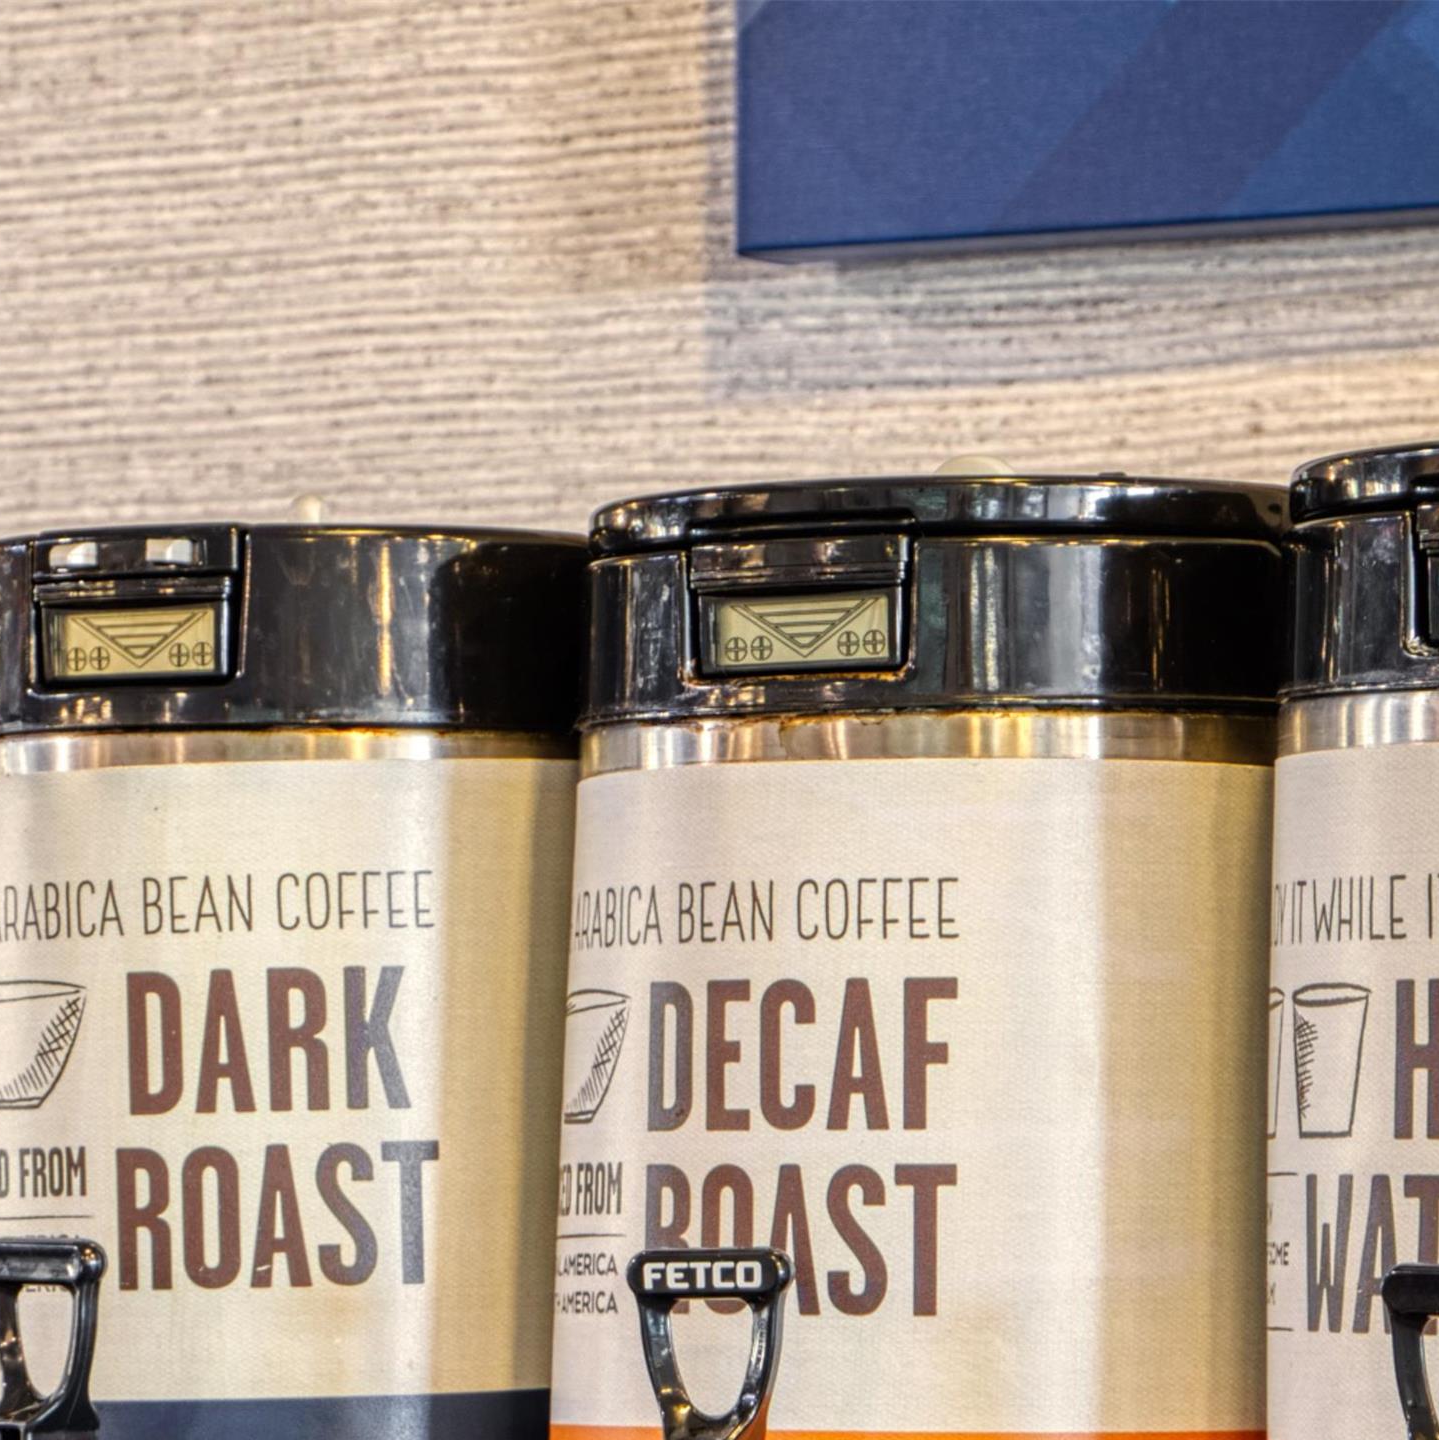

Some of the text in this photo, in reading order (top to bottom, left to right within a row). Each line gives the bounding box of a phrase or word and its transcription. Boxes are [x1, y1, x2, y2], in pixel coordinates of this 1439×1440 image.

[142, 874, 254, 935] BEAN
[276, 870, 437, 931] COFFEE
[677, 880, 775, 944] BEAN
[796, 877, 960, 941] COFFEE
[1312, 875, 1407, 943] WHILE
[126, 965, 412, 1116] DARK
[647, 977, 959, 1132] DECAF
[19, 1146, 87, 1198] FROM
[575, 1161, 623, 1216] FROM
[115, 1140, 440, 1291] ROAST
[644, 1163, 958, 1317] ROAST
[643, 1261, 762, 1290] FETCO
